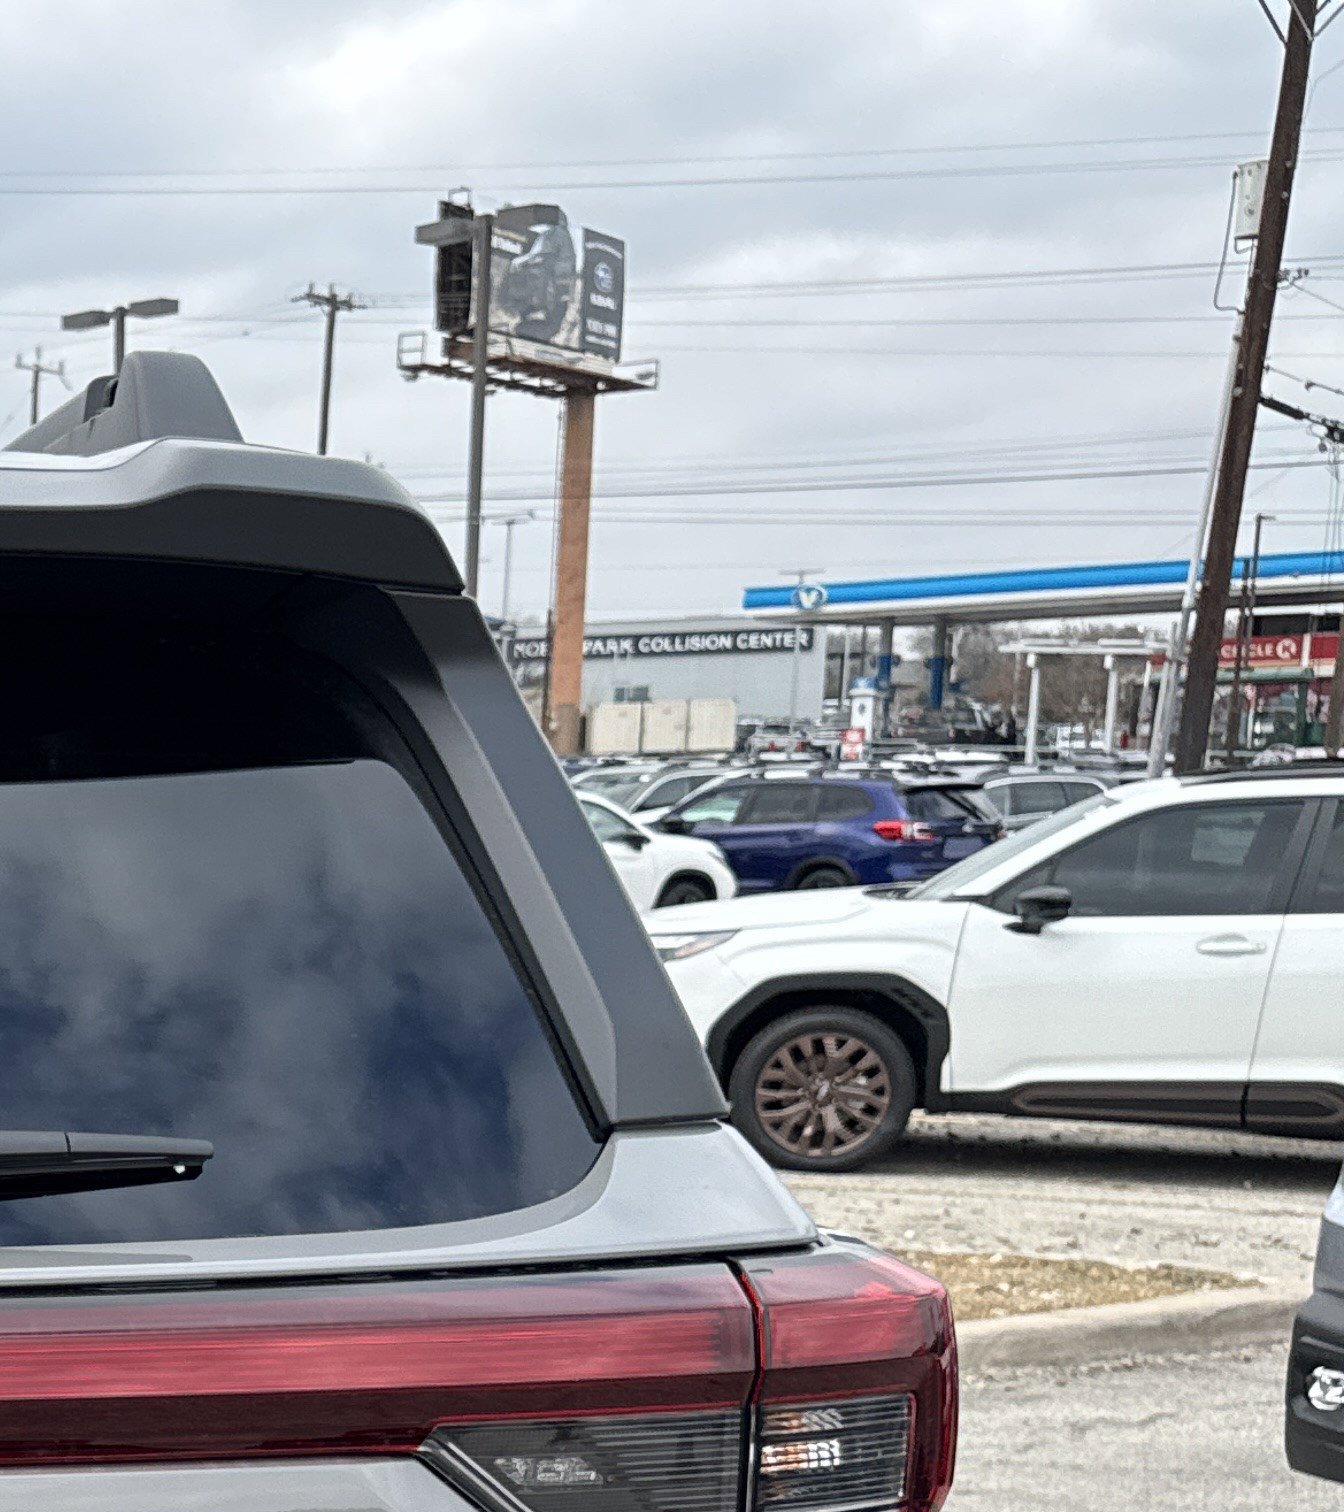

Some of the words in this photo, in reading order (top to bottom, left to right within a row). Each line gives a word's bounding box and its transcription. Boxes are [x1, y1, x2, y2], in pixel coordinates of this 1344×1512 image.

[513, 641, 548, 659] NOR
[582, 638, 635, 656] PARK
[637, 632, 734, 655] COLLISION
[736, 629, 810, 650] CENTER
